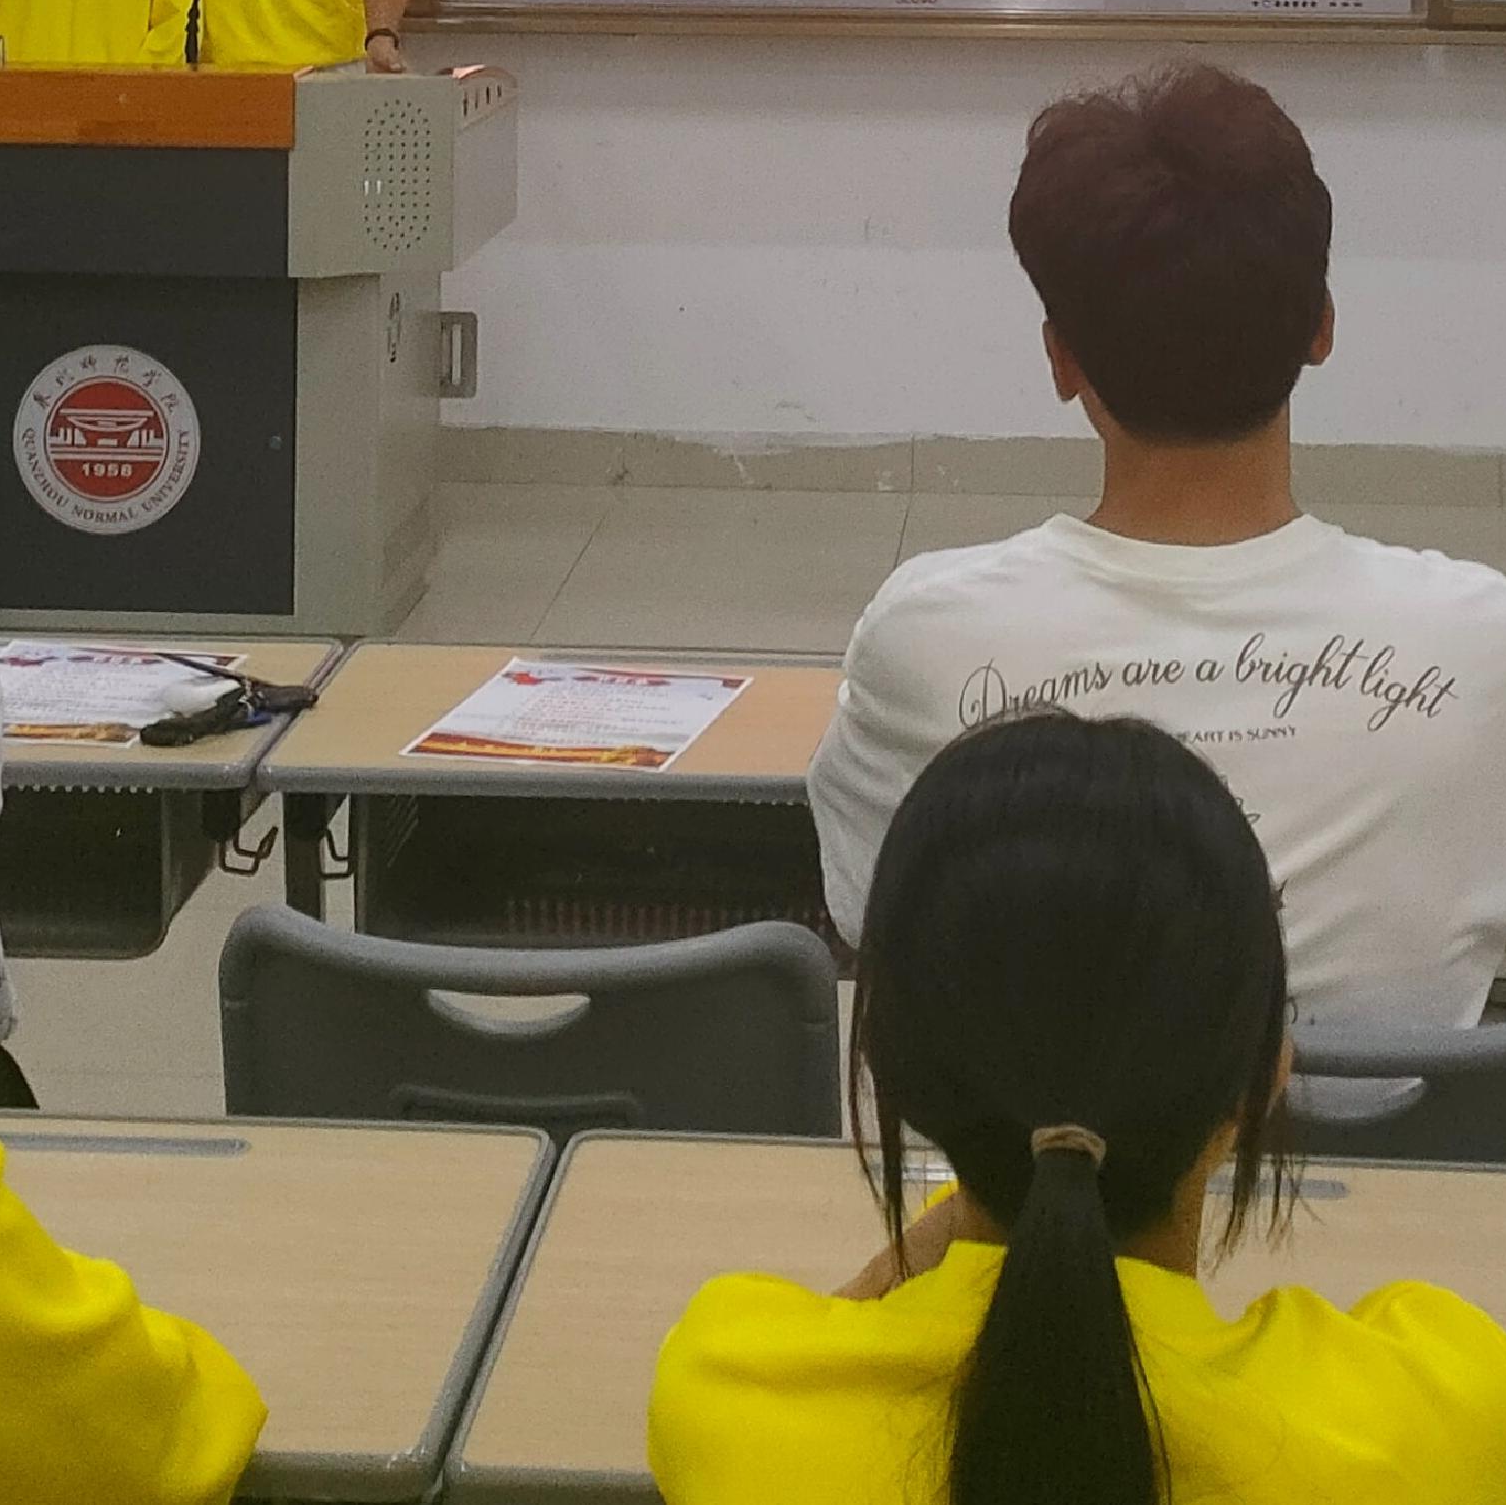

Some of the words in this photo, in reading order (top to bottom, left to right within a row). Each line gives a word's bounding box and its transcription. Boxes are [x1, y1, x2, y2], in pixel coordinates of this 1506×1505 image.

[21, 427, 69, 510] QUANZHOU
[72, 503, 139, 525] NORMAL
[141, 429, 191, 513] UNIVERSITY
[81, 463, 133, 478] 1958
[959, 657, 1112, 730] Dreams
[1122, 658, 1185, 688] are
[1195, 660, 1225, 682] a
[1235, 632, 1367, 720] bright
[1360, 644, 1459, 732] light
[1228, 729, 1244, 743] IS
[1246, 724, 1296, 742] SUNNY
